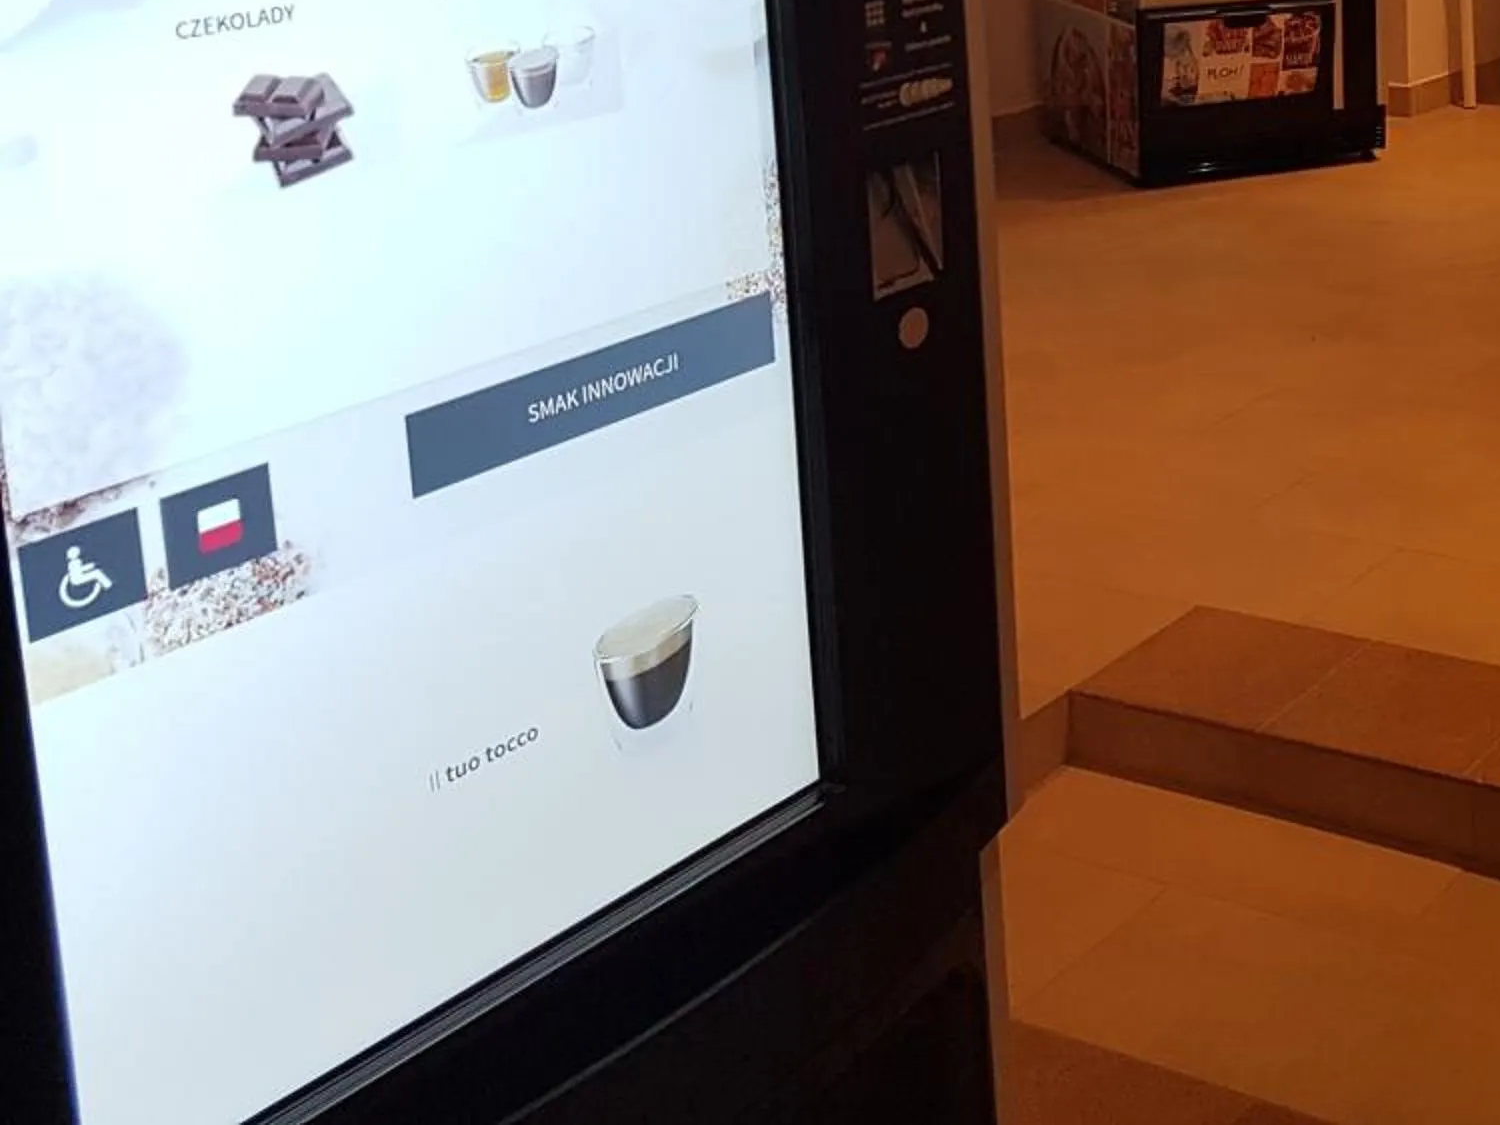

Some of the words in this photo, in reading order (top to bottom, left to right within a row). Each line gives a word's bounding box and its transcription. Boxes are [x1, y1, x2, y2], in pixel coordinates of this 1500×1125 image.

[175, 3, 296, 40] CZEKOLADY
[527, 388, 580, 424] SMAK
[581, 352, 680, 405] INNOWACJI
[446, 756, 481, 783] tuo
[485, 726, 539, 763] tocco
